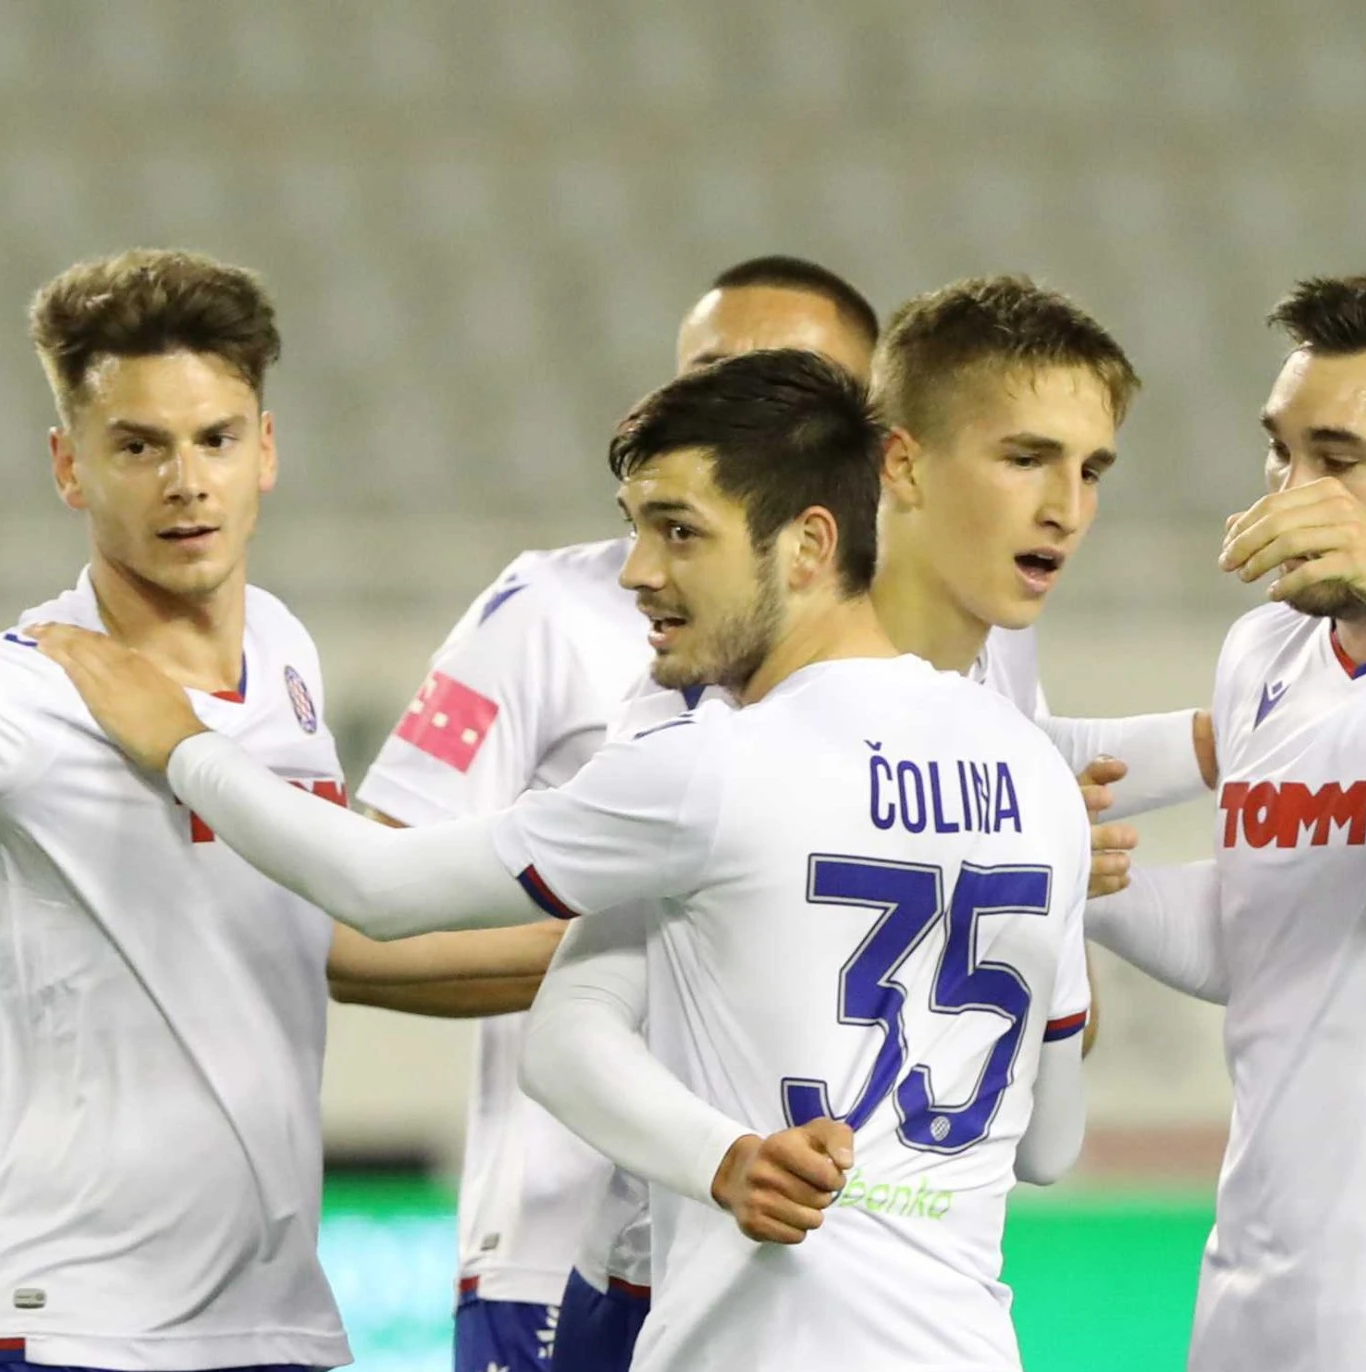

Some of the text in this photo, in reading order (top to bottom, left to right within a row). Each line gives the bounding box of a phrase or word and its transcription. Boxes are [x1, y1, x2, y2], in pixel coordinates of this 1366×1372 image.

[864, 740, 1022, 834] ČOLINA
[781, 853, 1053, 1155] 35
[833, 1168, 952, 1220] banka
